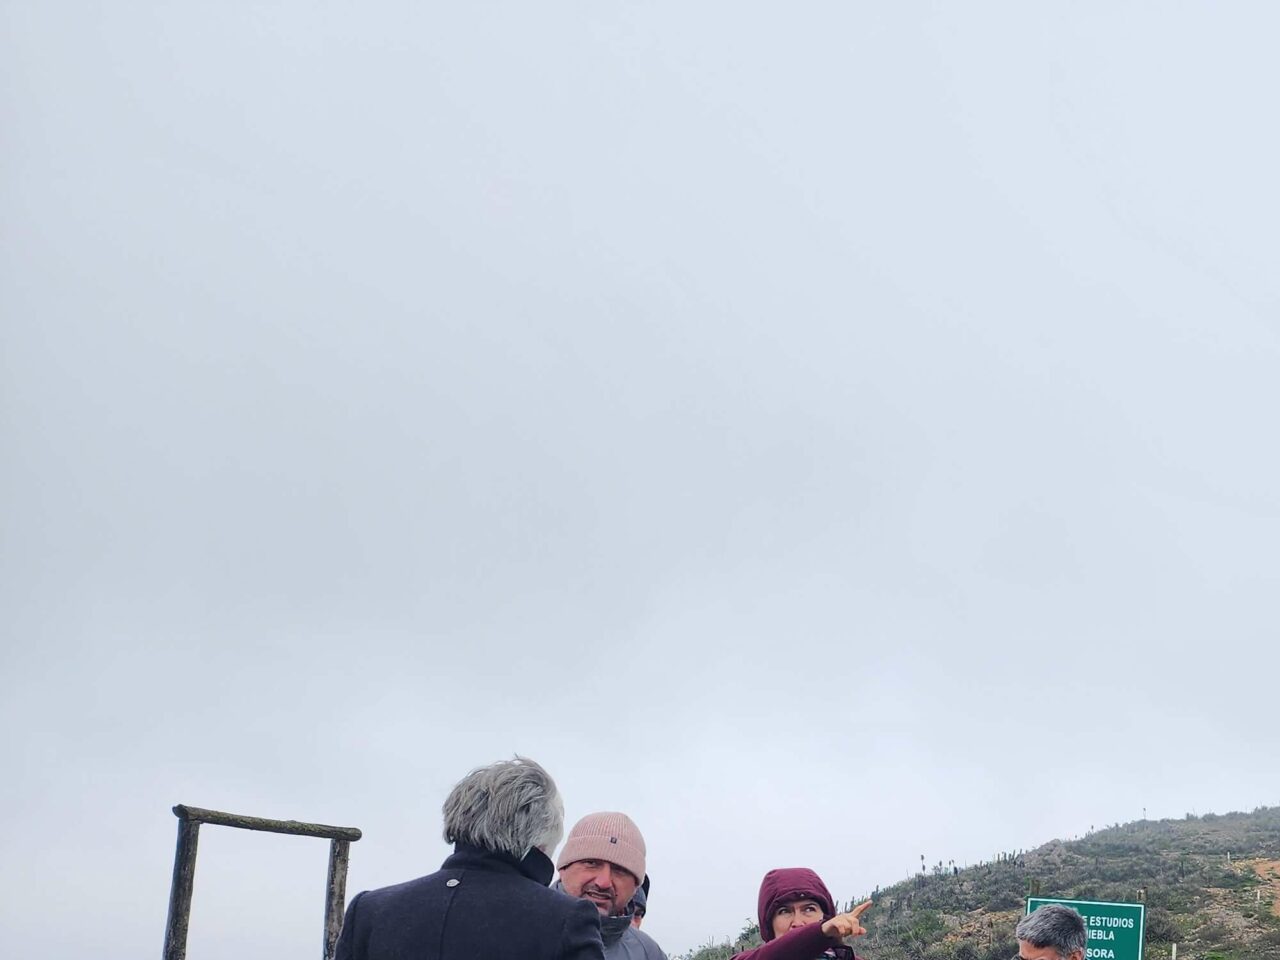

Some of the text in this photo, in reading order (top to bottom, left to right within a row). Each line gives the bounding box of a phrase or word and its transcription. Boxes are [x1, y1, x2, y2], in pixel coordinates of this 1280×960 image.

[1089, 916, 1134, 928] ESTUDIOS
[1087, 930, 1115, 940] IEBLA
[1086, 948, 1115, 959] SORA
